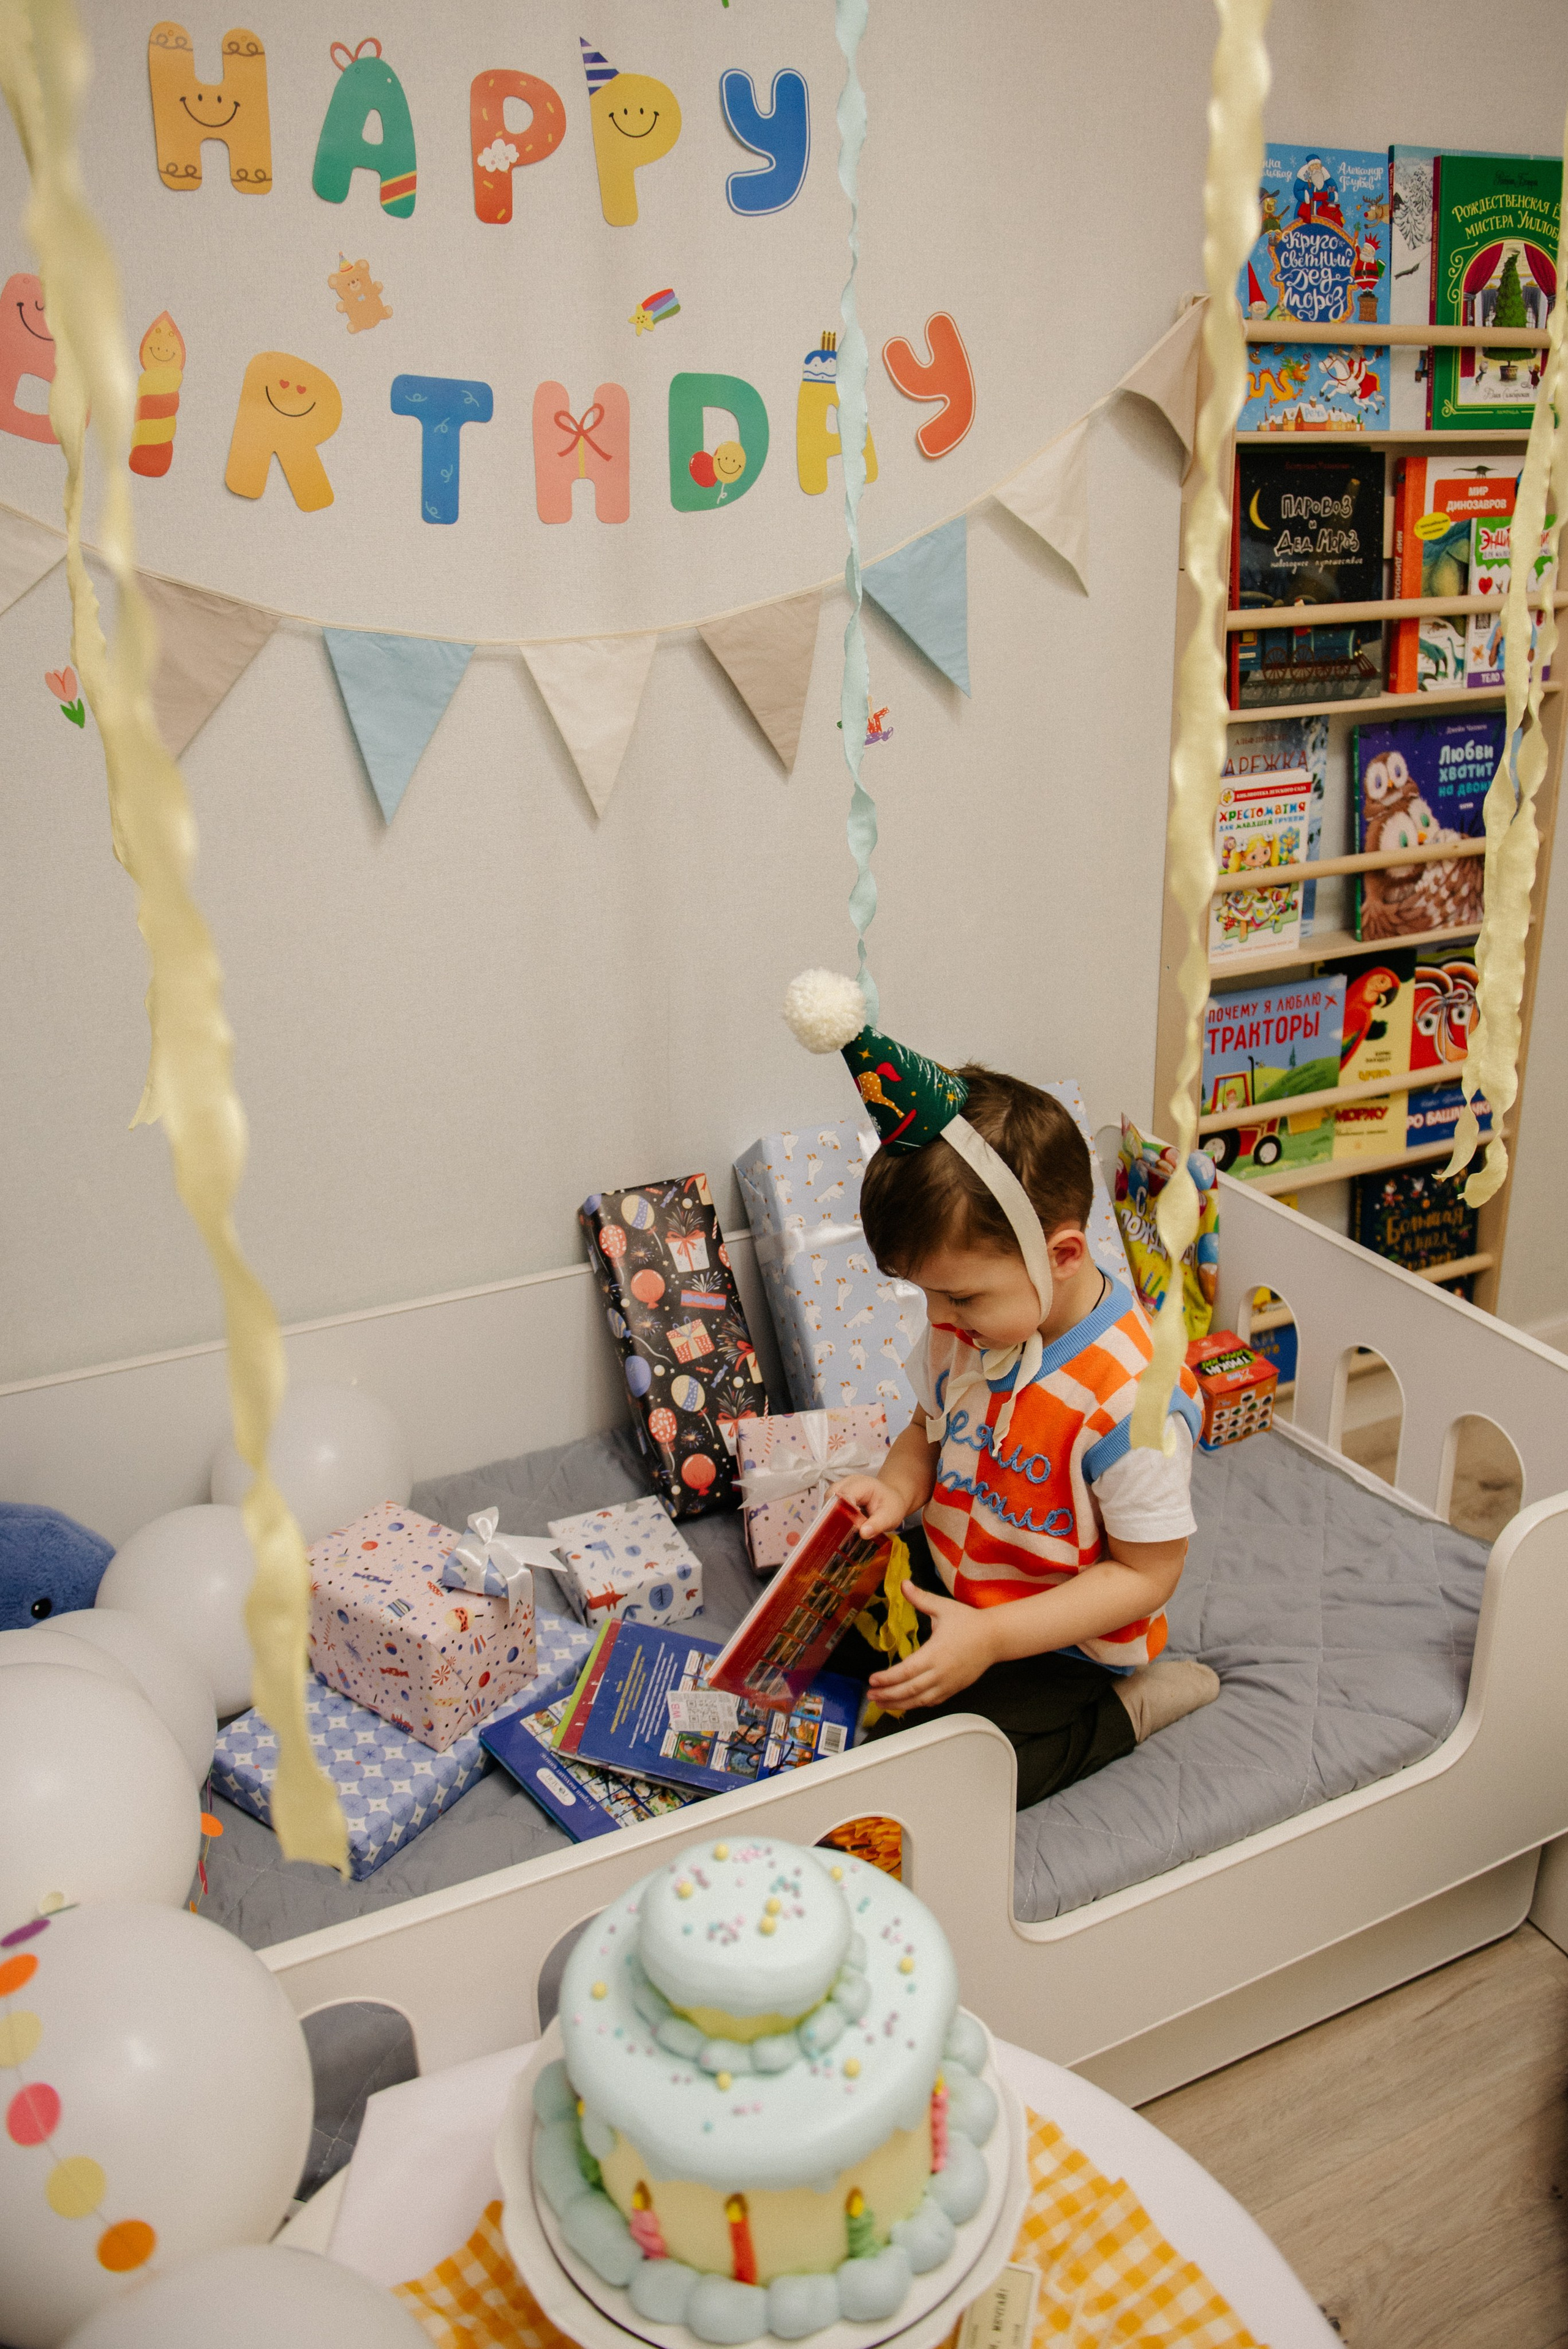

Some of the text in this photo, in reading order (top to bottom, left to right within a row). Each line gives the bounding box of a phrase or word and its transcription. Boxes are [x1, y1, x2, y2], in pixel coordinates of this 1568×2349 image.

[149, 21, 810, 227] HAPPY
[1338, 162, 1384, 181] Александр
[1452, 194, 1550, 223] РОЖДЕСТВЕНСКАЯ
[1464, 214, 1514, 239] МИСТЕРА
[1468, 486, 1488, 497] МИР
[1446, 499, 1507, 512] ДИНОЗАВРОВ
[1224, 750, 1309, 775] АРЕЖКА
[1439, 739, 1494, 765] Любви
[1208, 992, 1322, 1024] ПОЧЕМУ Я ЛЮБЛЮ
[1208, 1011, 1320, 1055] ТРАКТОРЫ
[671, 1703, 680, 1718] WB
